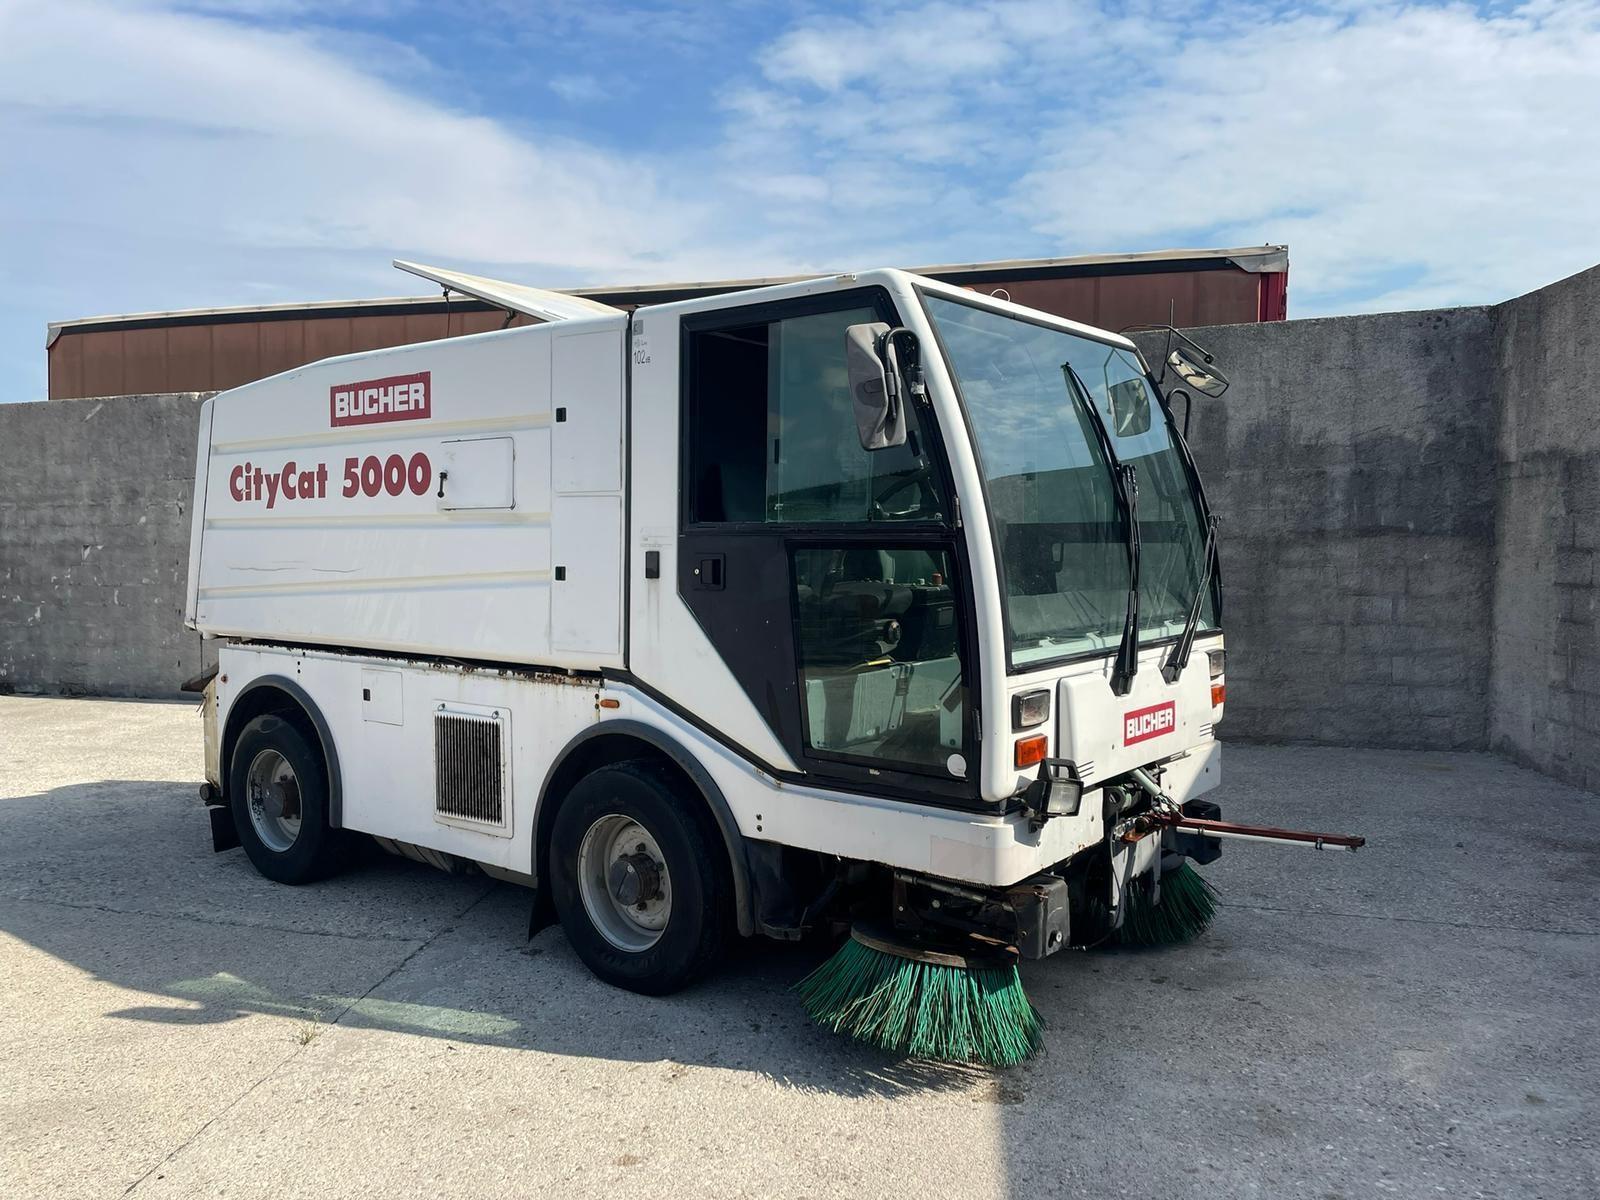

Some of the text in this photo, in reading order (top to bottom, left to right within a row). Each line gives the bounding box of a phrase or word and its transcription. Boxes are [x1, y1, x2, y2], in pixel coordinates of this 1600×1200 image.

[335, 382, 425, 418] BUCHER
[229, 452, 431, 509] CityCat 5000
[1126, 707, 1173, 740] BUCHER
